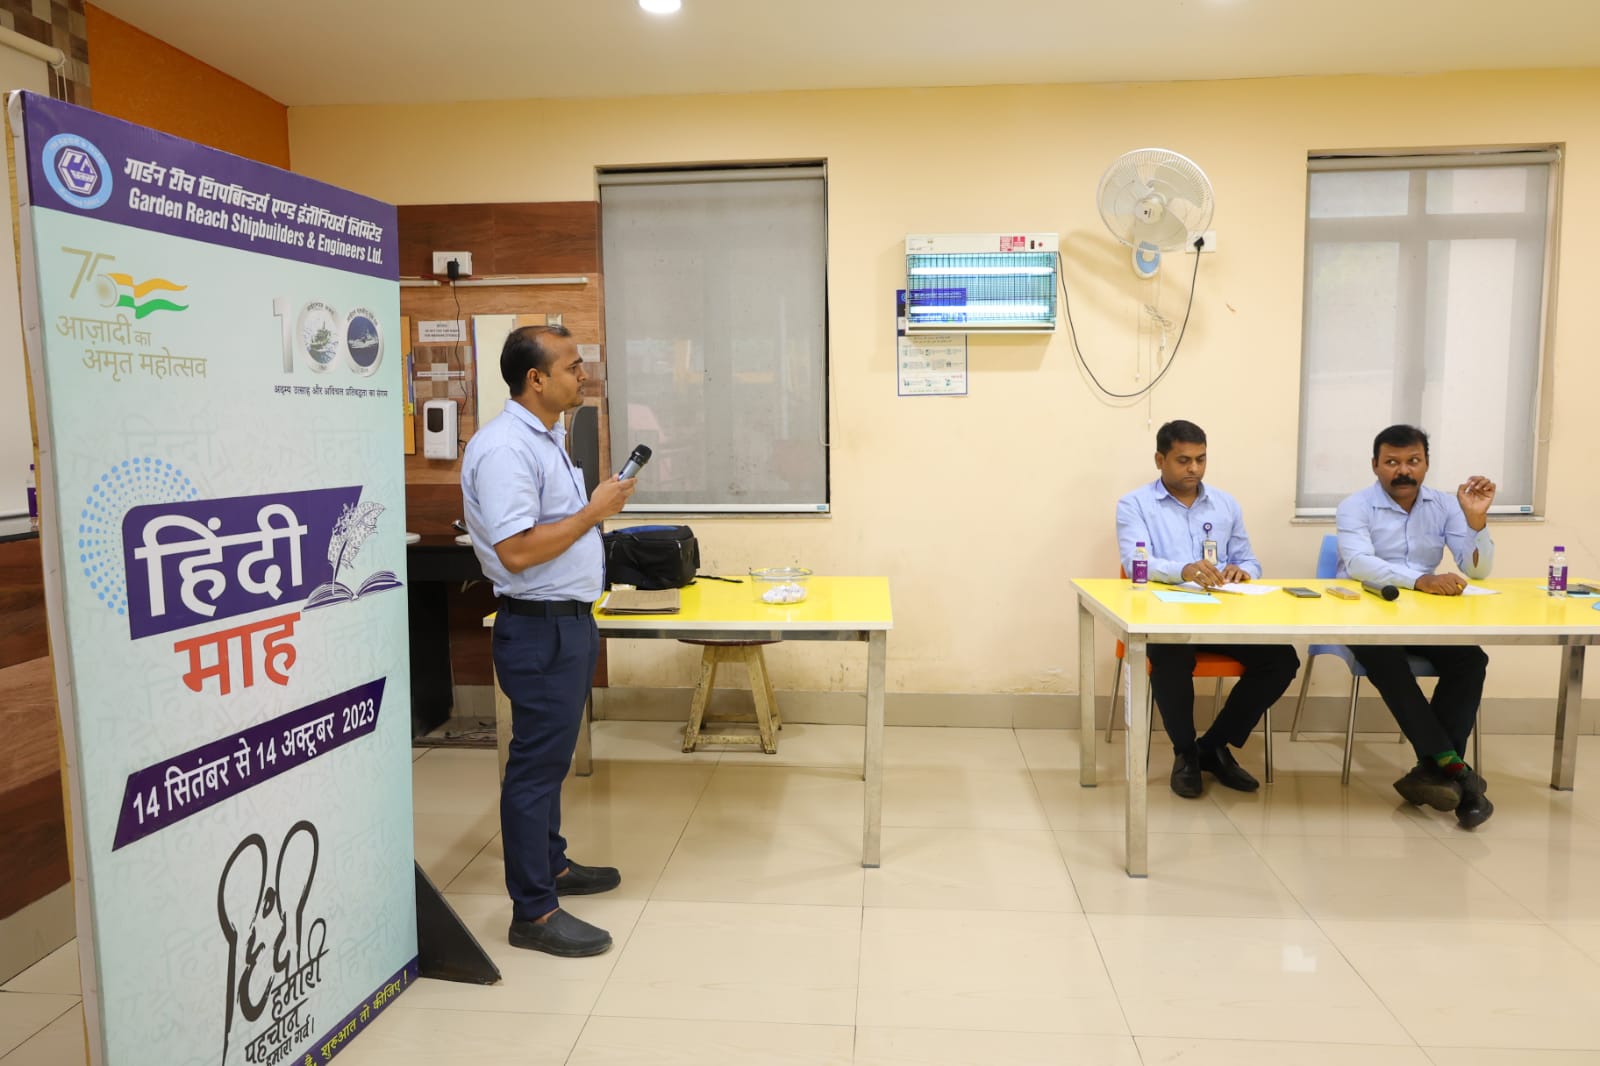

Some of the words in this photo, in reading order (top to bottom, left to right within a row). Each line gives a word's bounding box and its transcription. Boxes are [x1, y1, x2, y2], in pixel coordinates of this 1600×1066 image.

[124, 157, 167, 186] गार्डन
[168, 166, 196, 194] रीच
[271, 198, 298, 220] एण्ड
[297, 203, 347, 233] इंजीनियर्स
[347, 215, 383, 242] लिमिटेड
[129, 187, 183, 219] Garden
[185, 201, 229, 230] Reach
[231, 213, 305, 247] Shipbuilders
[306, 231, 316, 249] &
[317, 234, 366, 260] Engineers
[366, 246, 383, 264] Ltd.
[56, 313, 132, 345] आज़ादी
[133, 330, 152, 346] का
[82, 349, 134, 382] अमृत
[138, 346, 208, 379] महोत्सव
[134, 503, 308, 617] हिंदी
[174, 612, 301, 696] माह
[132, 785, 161, 825] 14
[164, 756, 230, 812] सितंबर
[233, 738, 251, 781] से
[256, 736, 278, 770] 14
[281, 712, 335, 758] अक्टूबर
[342, 698, 375, 734] 2023
[245, 997, 310, 1064] पहचान
[372, 979, 401, 1009] कीजिए
